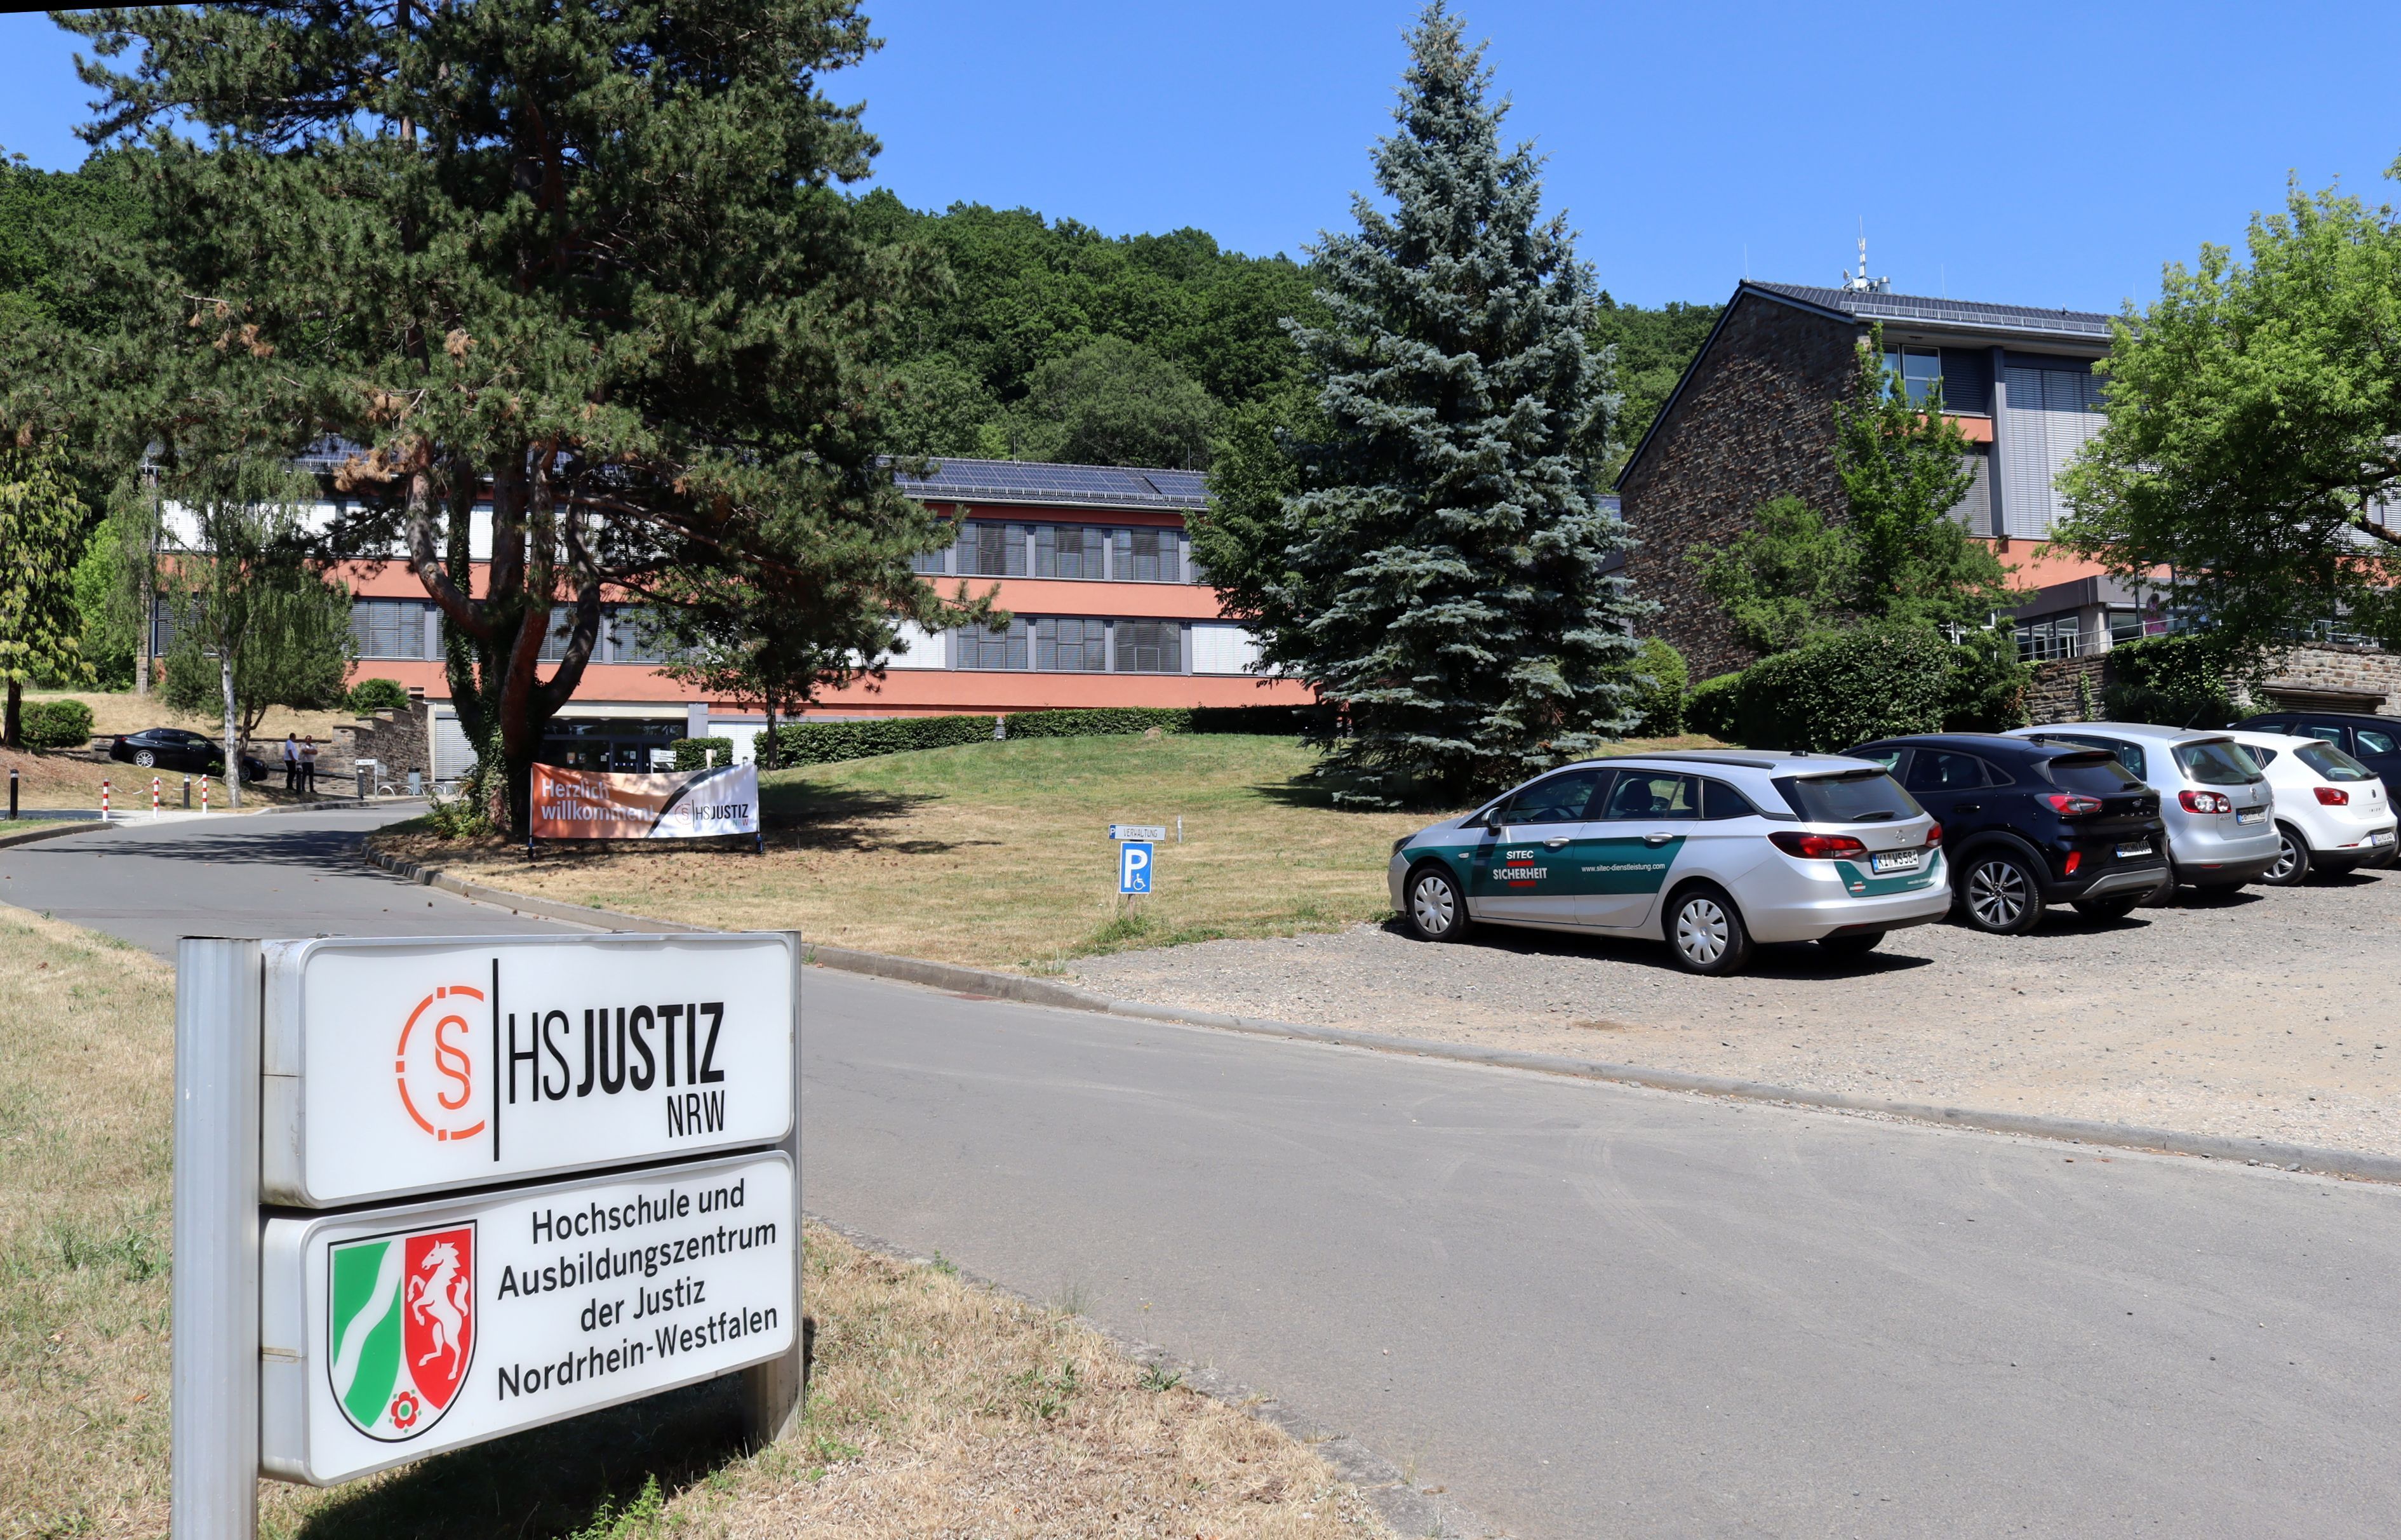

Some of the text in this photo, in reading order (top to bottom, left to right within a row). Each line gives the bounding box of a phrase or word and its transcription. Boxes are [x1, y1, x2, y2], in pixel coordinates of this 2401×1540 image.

[542, 778, 610, 800] Herzlich
[542, 800, 654, 821] willkommen!
[1123, 829, 1158, 838] VERWALTUNG
[1124, 849, 1148, 888] P
[1506, 850, 1534, 859] SITEC
[1581, 863, 1665, 873] www.sitec-dienstleistung.com
[1493, 867, 1548, 880] SICHERHEIT
[667, 1089, 725, 1138] NRW
[532, 1178, 746, 1245] Hochschule und
[497, 1223, 777, 1301] Ausbildungszentrum
[580, 1276, 706, 1331] der Justiz
[497, 1305, 779, 1401] Nordrhein-Westfalen
